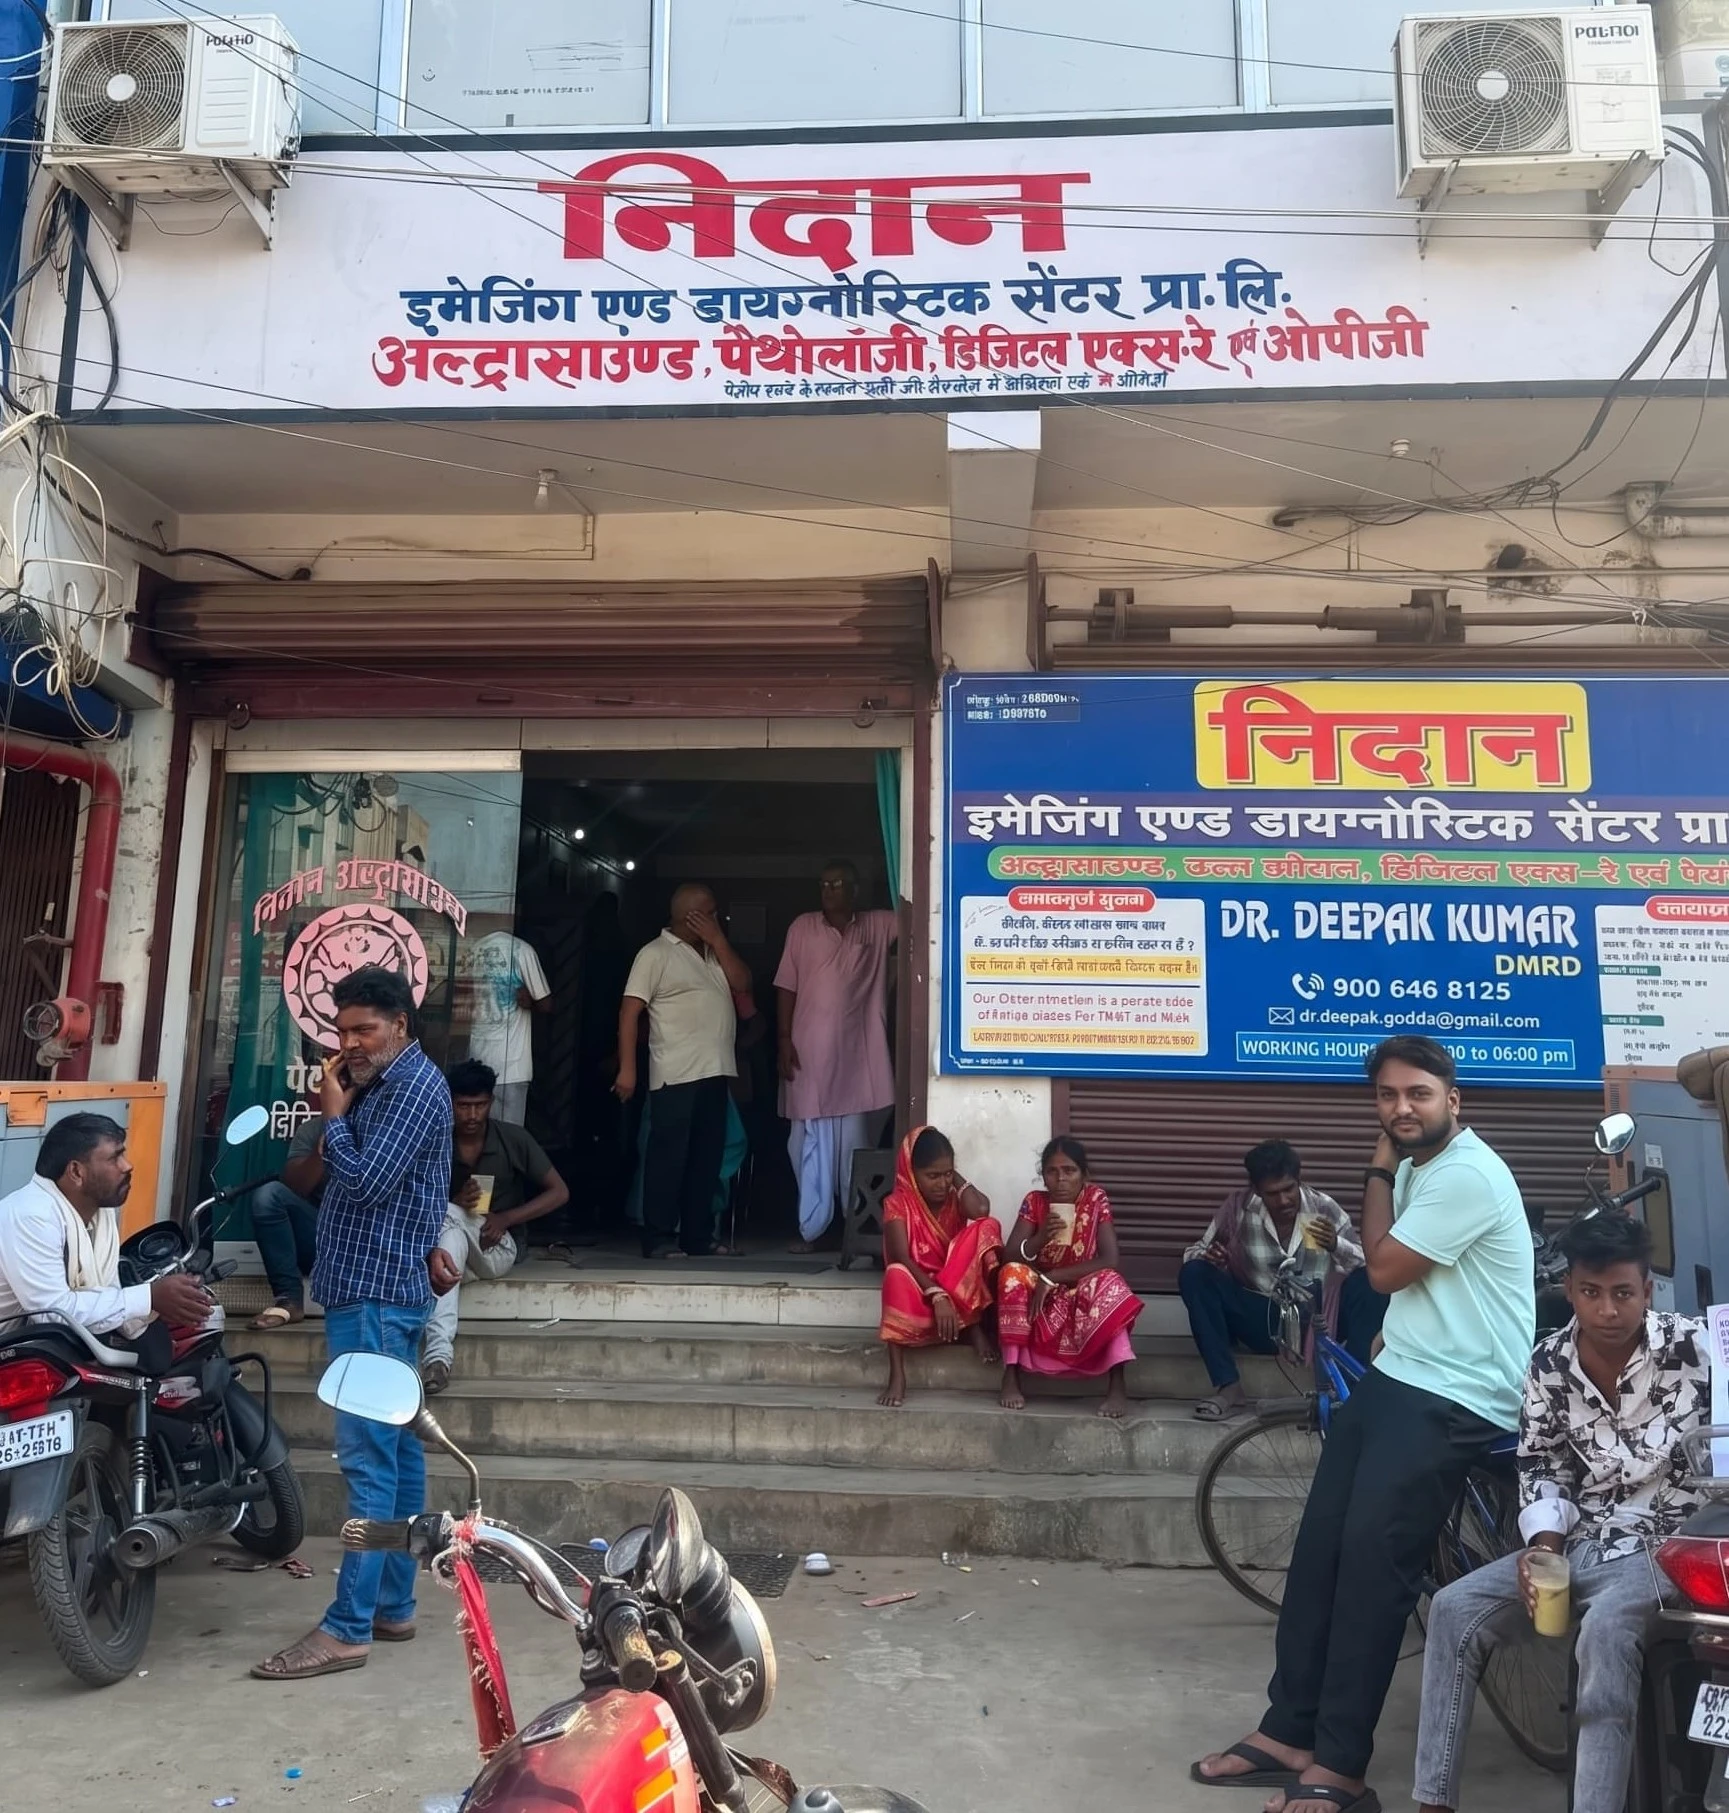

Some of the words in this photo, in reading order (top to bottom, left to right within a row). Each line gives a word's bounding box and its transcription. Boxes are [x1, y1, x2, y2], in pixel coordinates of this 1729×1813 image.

[538, 152, 1091, 272] निदान
[400, 275, 582, 337] इमेजिंग
[592, 290, 677, 336] एण्ड
[689, 268, 990, 326] डायग्नोस्टिक
[1003, 262, 1136, 324] सेंटर
[939, 324, 1071, 374] डिजिटल
[1264, 305, 1430, 362] ओपीजी
[1207, 687, 1573, 788] निदान
[964, 793, 1123, 842] इमेजिंग
[1135, 806, 1233, 842] एण्ड
[1245, 795, 1535, 842] डायग्नोस्टिक
[1548, 798, 1662, 845] सेंटर
[1380, 852, 1500, 882] डिजिटल
[1626, 859, 1671, 888] एवं
[1221, 900, 1279, 943] DR.
[1294, 901, 1435, 945] DEEPAK
[1447, 903, 1579, 948] KUMAR
[1495, 954, 1581, 977] DMRD
[1333, 979, 1381, 998] 900
[1390, 980, 1438, 999] 646
[1447, 981, 1511, 1001] 8125
[1135, 1011, 1157, 1024] and
[1300, 1009, 1540, 1029] dr.deepak.godda@gmail.com
[1243, 1040, 1319, 1057] WORKING
[1471, 1047, 1488, 1060] to
[1493, 1047, 1538, 1062] 06:00
[1543, 1050, 1568, 1067] pm
